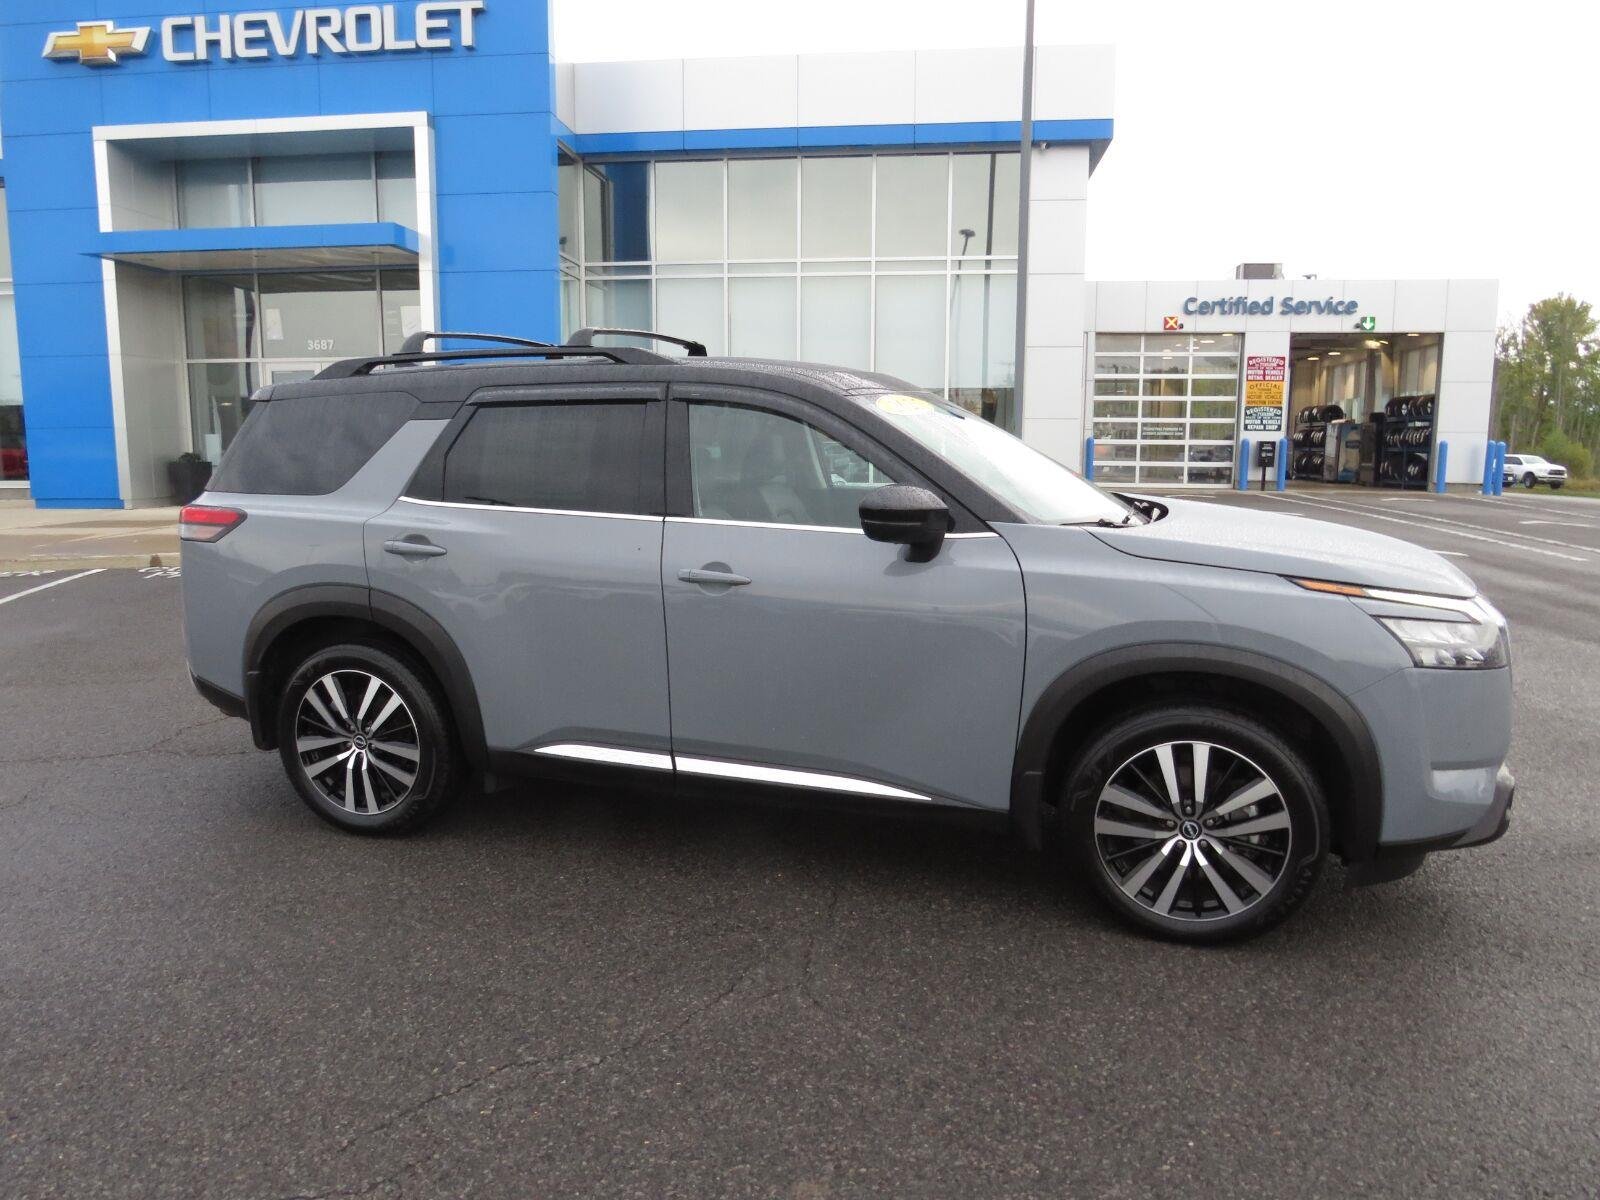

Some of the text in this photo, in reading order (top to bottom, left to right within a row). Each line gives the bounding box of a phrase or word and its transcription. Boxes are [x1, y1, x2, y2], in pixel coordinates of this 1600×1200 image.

[161, 1, 485, 62] CHEVROLET
[1183, 296, 1359, 316] Certified Service
[307, 339, 335, 351] 3687
[1248, 357, 1285, 366] REGISTERED
[1246, 407, 1281, 415] REGISTERED
